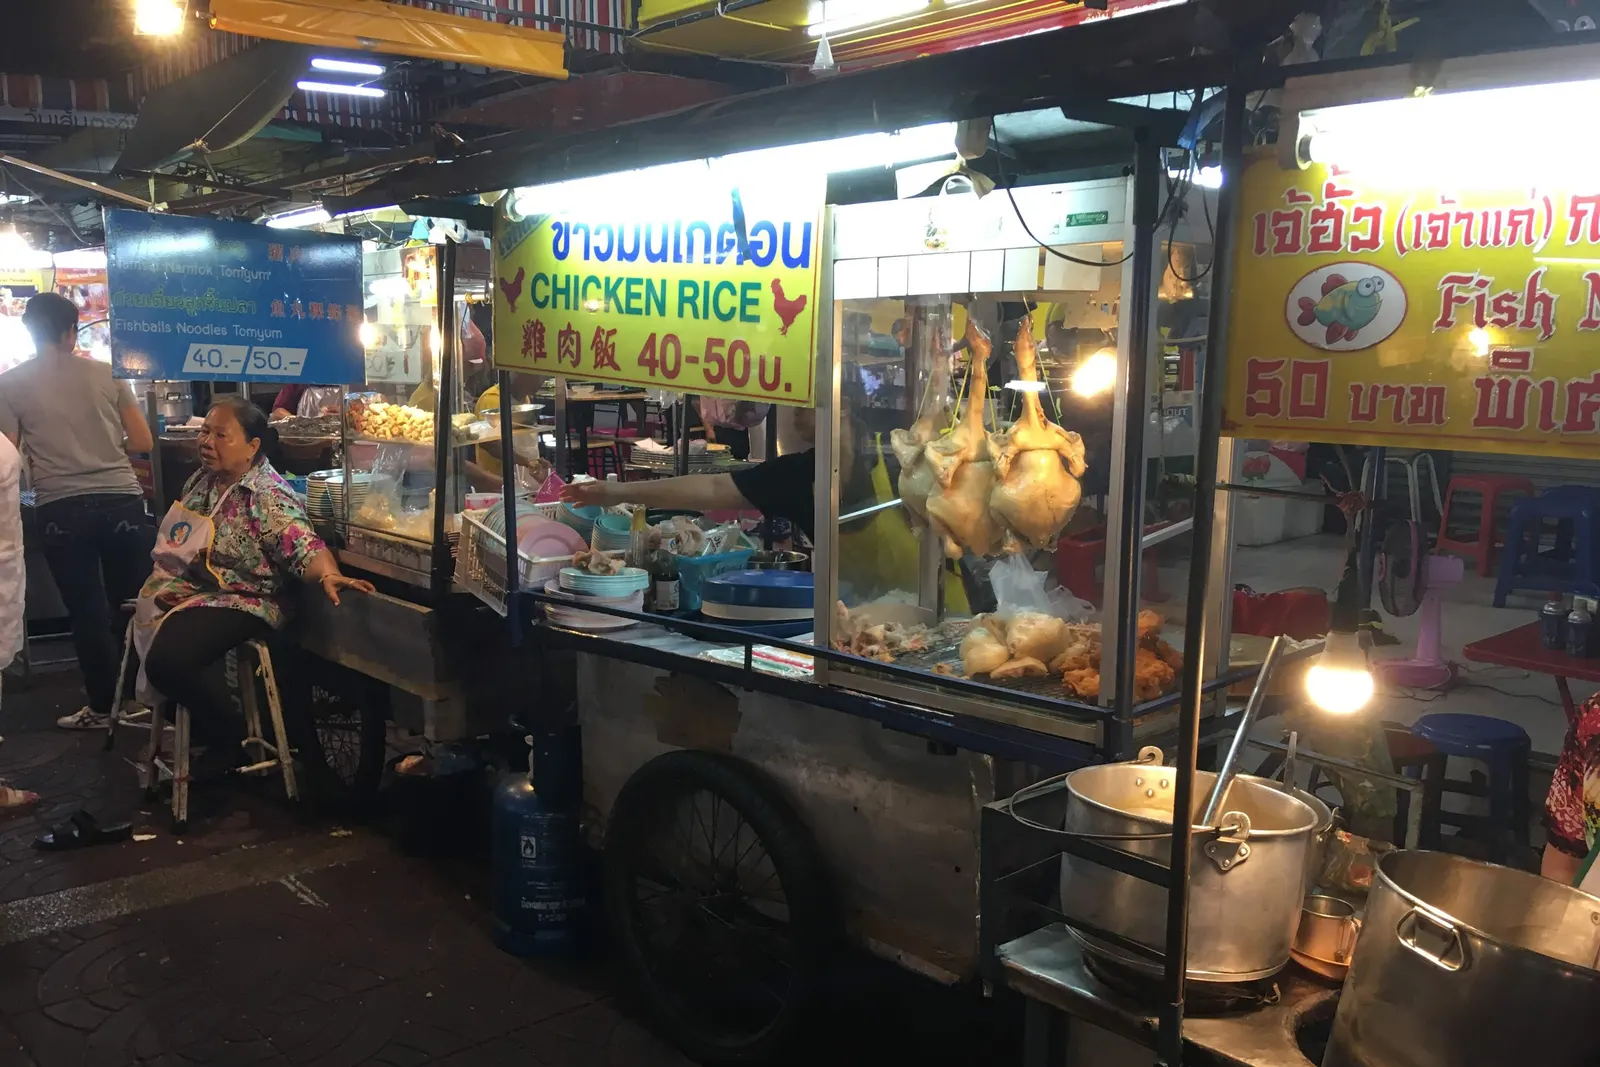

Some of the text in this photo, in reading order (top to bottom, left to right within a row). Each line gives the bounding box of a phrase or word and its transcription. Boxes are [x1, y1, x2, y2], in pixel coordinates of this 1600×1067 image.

[531, 272, 762, 323] CHICKEN RICE
[1432, 266, 1558, 341] Fish
[114, 318, 283, 341] Fishballs Noodles Tomyum
[521, 318, 621, 371] 雞肉飯
[192, 348, 300, 372] 40.- 50.-
[1245, 346, 1600, 434] 50 บาท พิเศ
